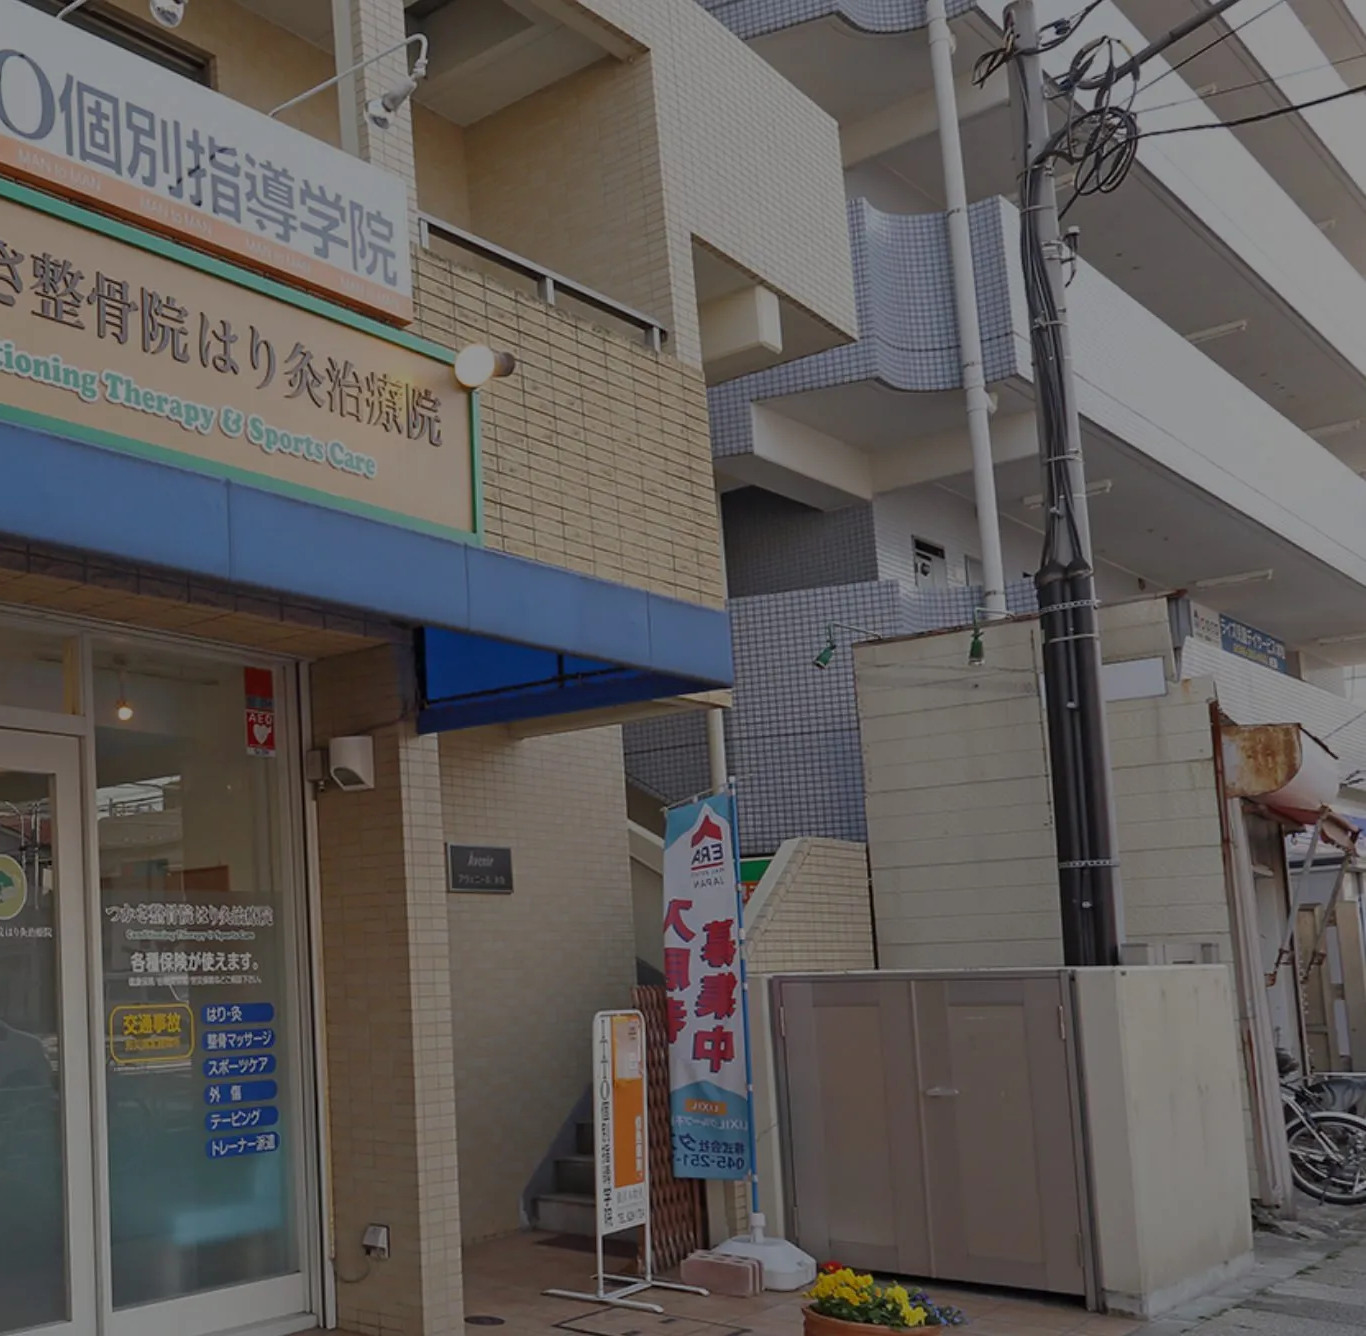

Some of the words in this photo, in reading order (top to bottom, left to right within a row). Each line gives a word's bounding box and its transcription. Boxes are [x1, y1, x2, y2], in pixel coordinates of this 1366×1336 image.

[17, 147, 53, 172] MAN
[69, 166, 102, 191] MAN
[101, 371, 214, 436] Therapy
[223, 403, 243, 435] &
[246, 411, 328, 464] Sports
[328, 441, 378, 478] Care
[130, 952, 259, 973] 各種保険が使えます。
[123, 1011, 182, 1036] 交通事故
[206, 1006, 243, 1023] はり・灸
[207, 1030, 272, 1049] 整骨マッサージ
[208, 1057, 269, 1077] スポーツケア
[210, 1109, 261, 1130] テーピング
[211, 1133, 277, 1157] トレーナー派遣
